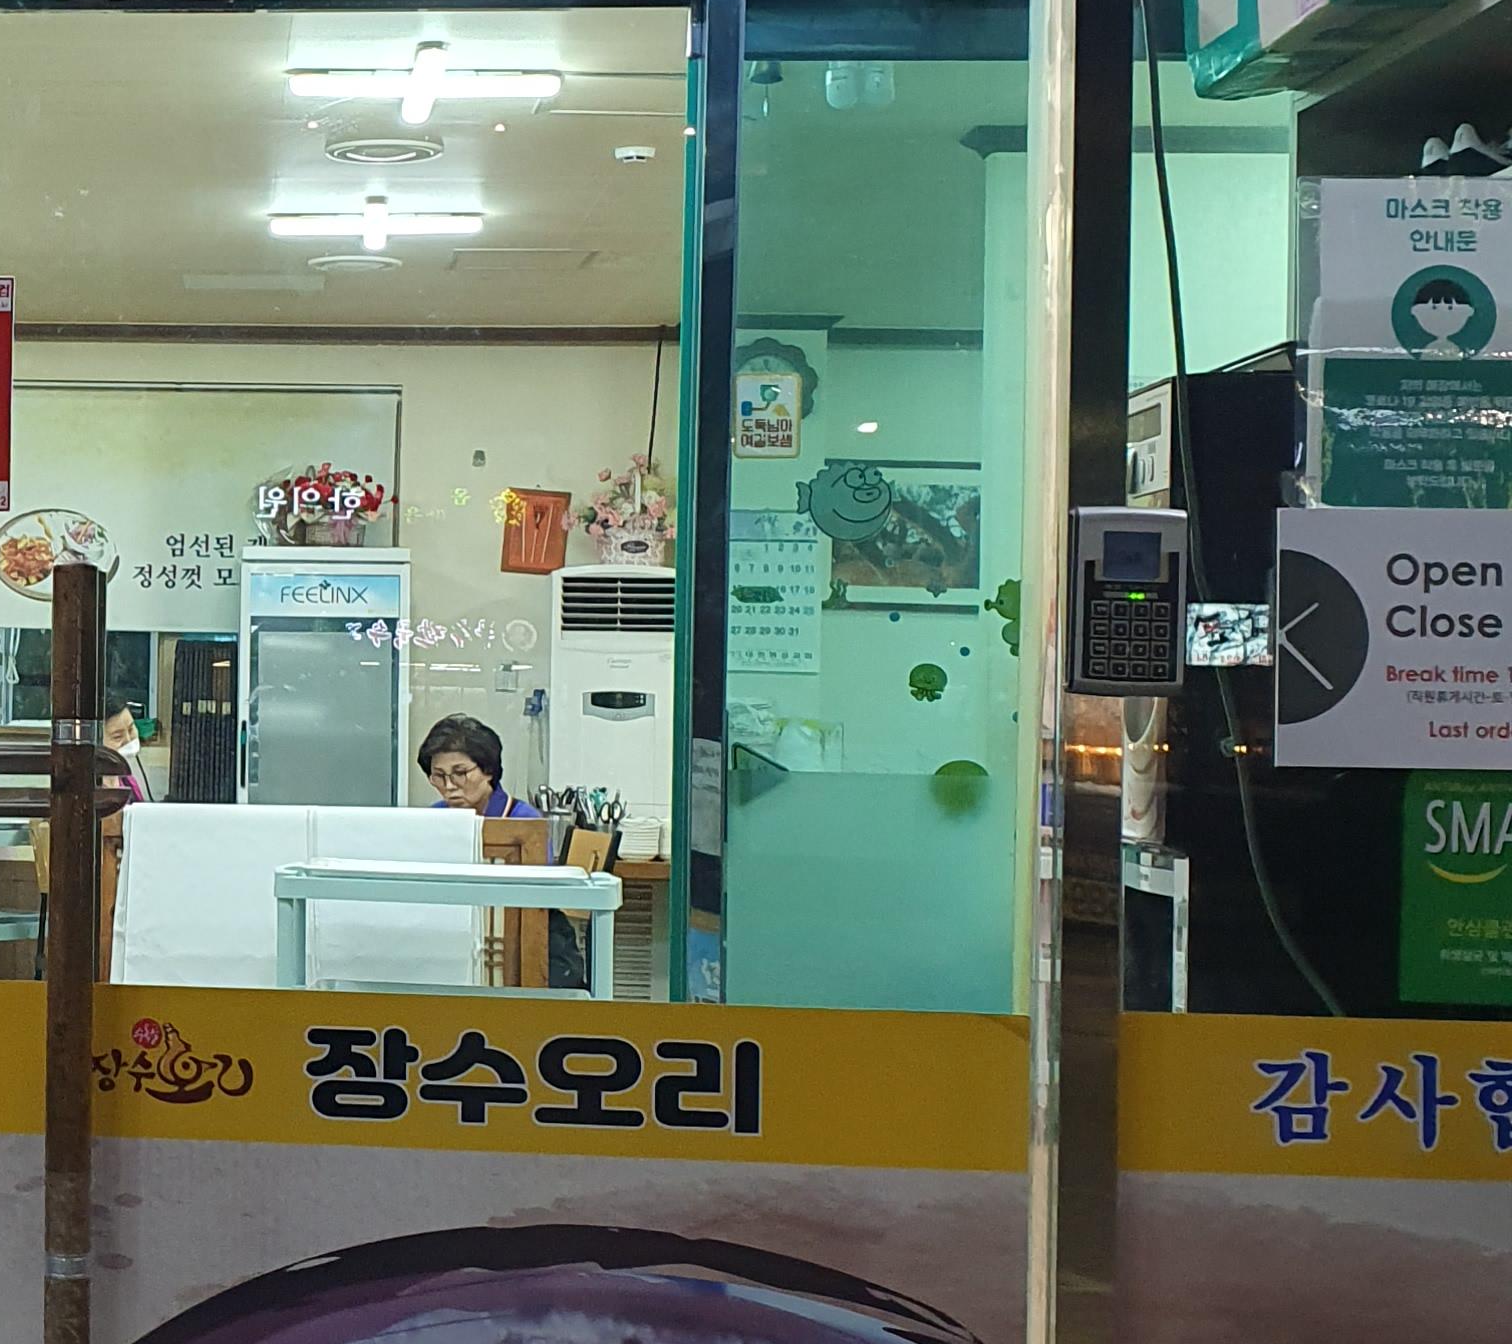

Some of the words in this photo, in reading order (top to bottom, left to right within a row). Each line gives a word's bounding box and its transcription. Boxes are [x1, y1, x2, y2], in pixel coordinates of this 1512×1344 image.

[1386, 197, 1451, 220] 마스크
[1460, 197, 1503, 221] 착용
[1410, 229, 1477, 253] 안내문
[165, 534, 235, 558] 엄선된
[132, 565, 203, 589] 정성껏
[1386, 553, 1503, 593] Open
[280, 583, 369, 604] FEELINX
[1386, 605, 1503, 638] Close
[1386, 665, 1447, 683] Break
[1452, 666, 1499, 683] time
[1429, 721, 1469, 738] Last
[1476, 721, 1512, 739] ord
[302, 1025, 764, 1137] 장수오리
